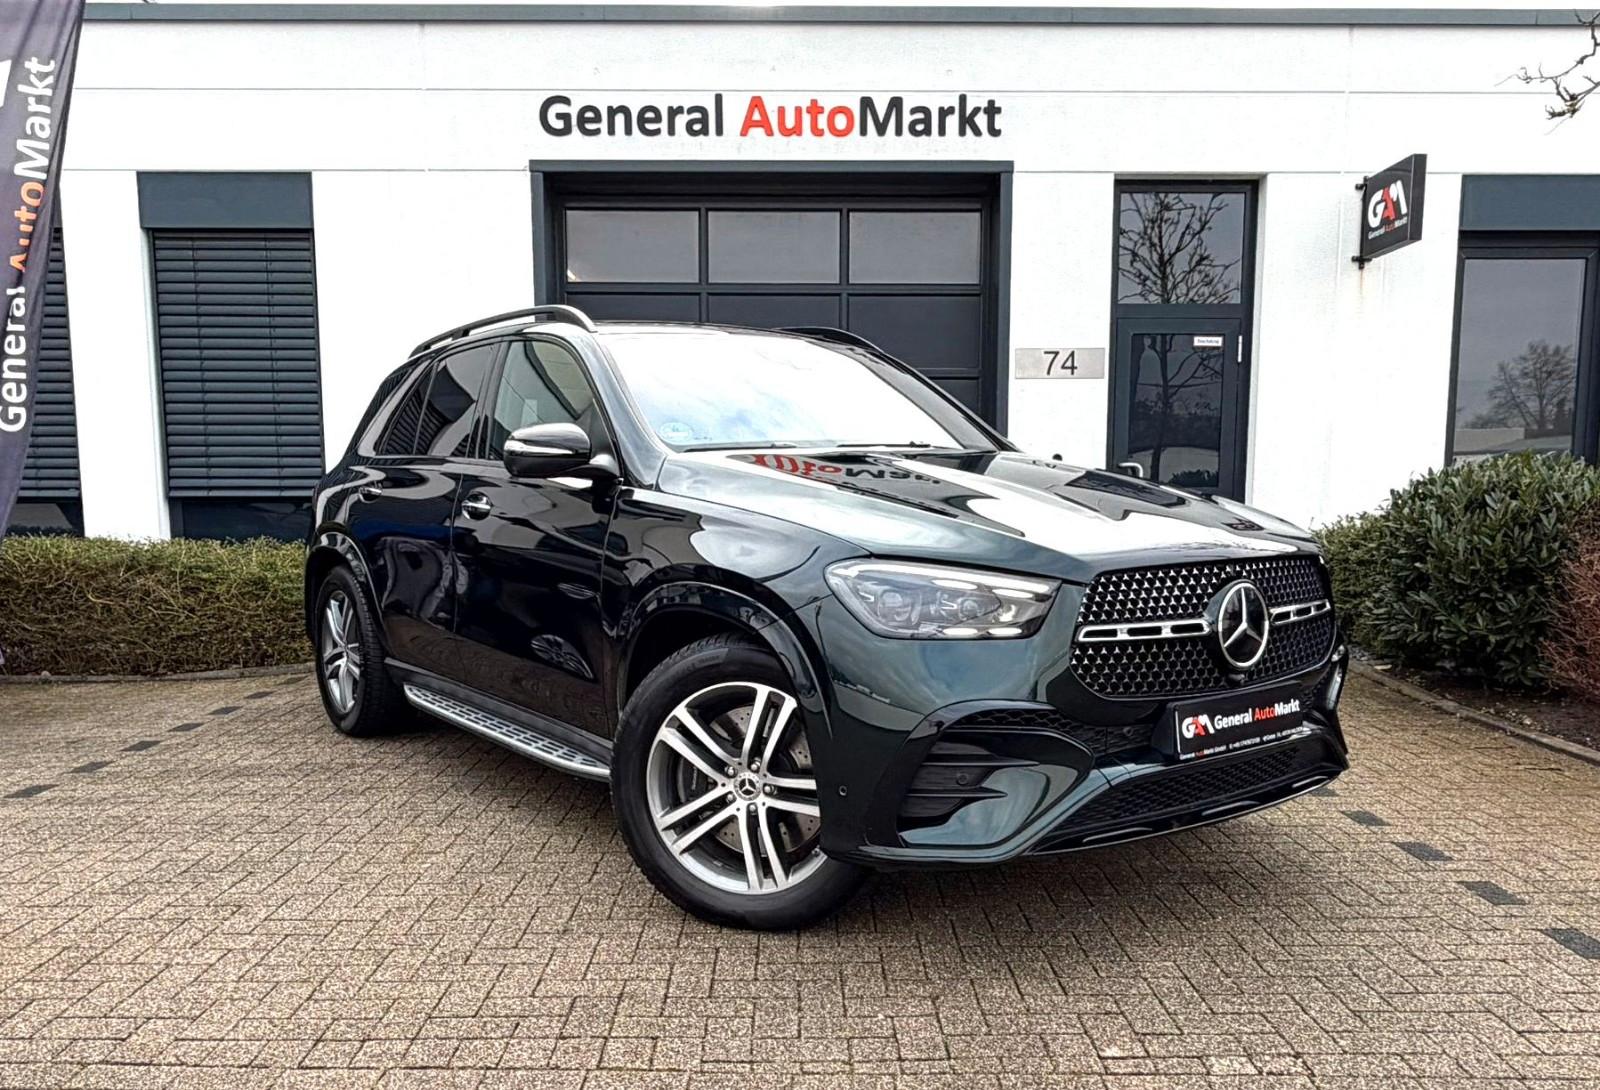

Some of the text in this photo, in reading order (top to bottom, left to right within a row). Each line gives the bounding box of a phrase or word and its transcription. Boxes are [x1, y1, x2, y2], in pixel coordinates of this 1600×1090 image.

[539, 93, 1002, 137] General AutoMarkt
[1043, 350, 1078, 376] 74
[1214, 708, 1253, 729] General
[1254, 698, 1300, 721] AutoMarkt
